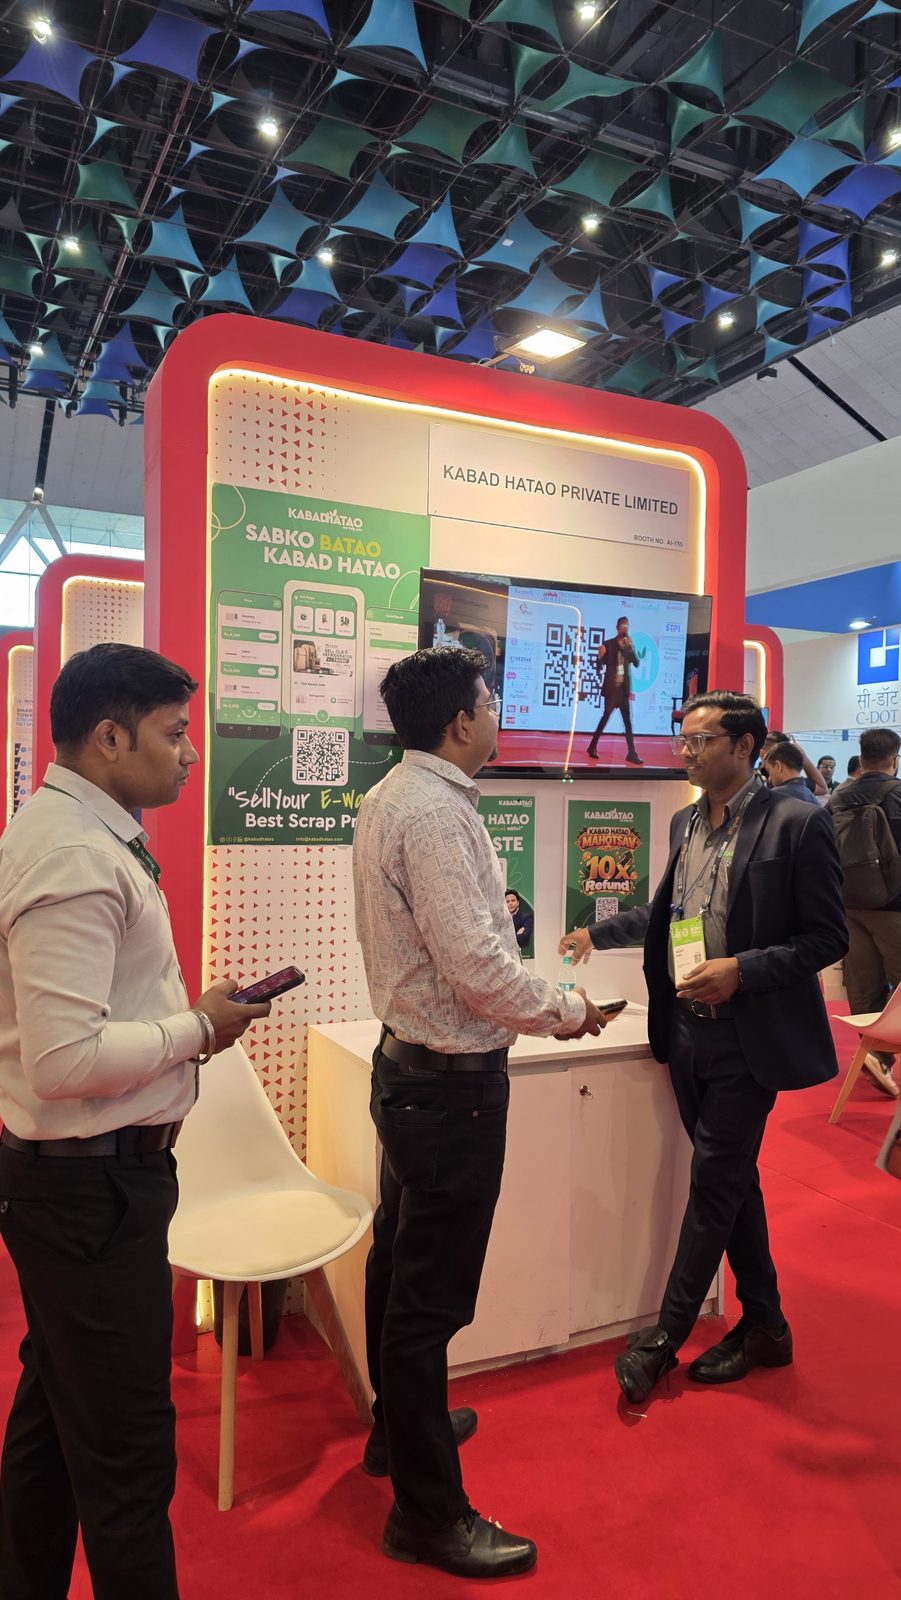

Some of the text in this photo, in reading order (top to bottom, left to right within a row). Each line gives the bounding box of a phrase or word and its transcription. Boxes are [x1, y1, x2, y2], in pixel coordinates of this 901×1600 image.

[443, 465, 679, 515] KABAD HATAO PRIVATE LIMITED
[245, 523, 382, 558] SABKO BATAO
[633, 534, 655, 544] BOOTH
[263, 546, 401, 580] KABAD HATAO
[856, 709, 899, 725] C-DOT
[245, 813, 284, 828] Best
[288, 813, 337, 832] Scrap
[488, 813, 530, 825] HATAO
[581, 835, 637, 850] MAHOTSAV
[584, 879, 631, 892] Refund
